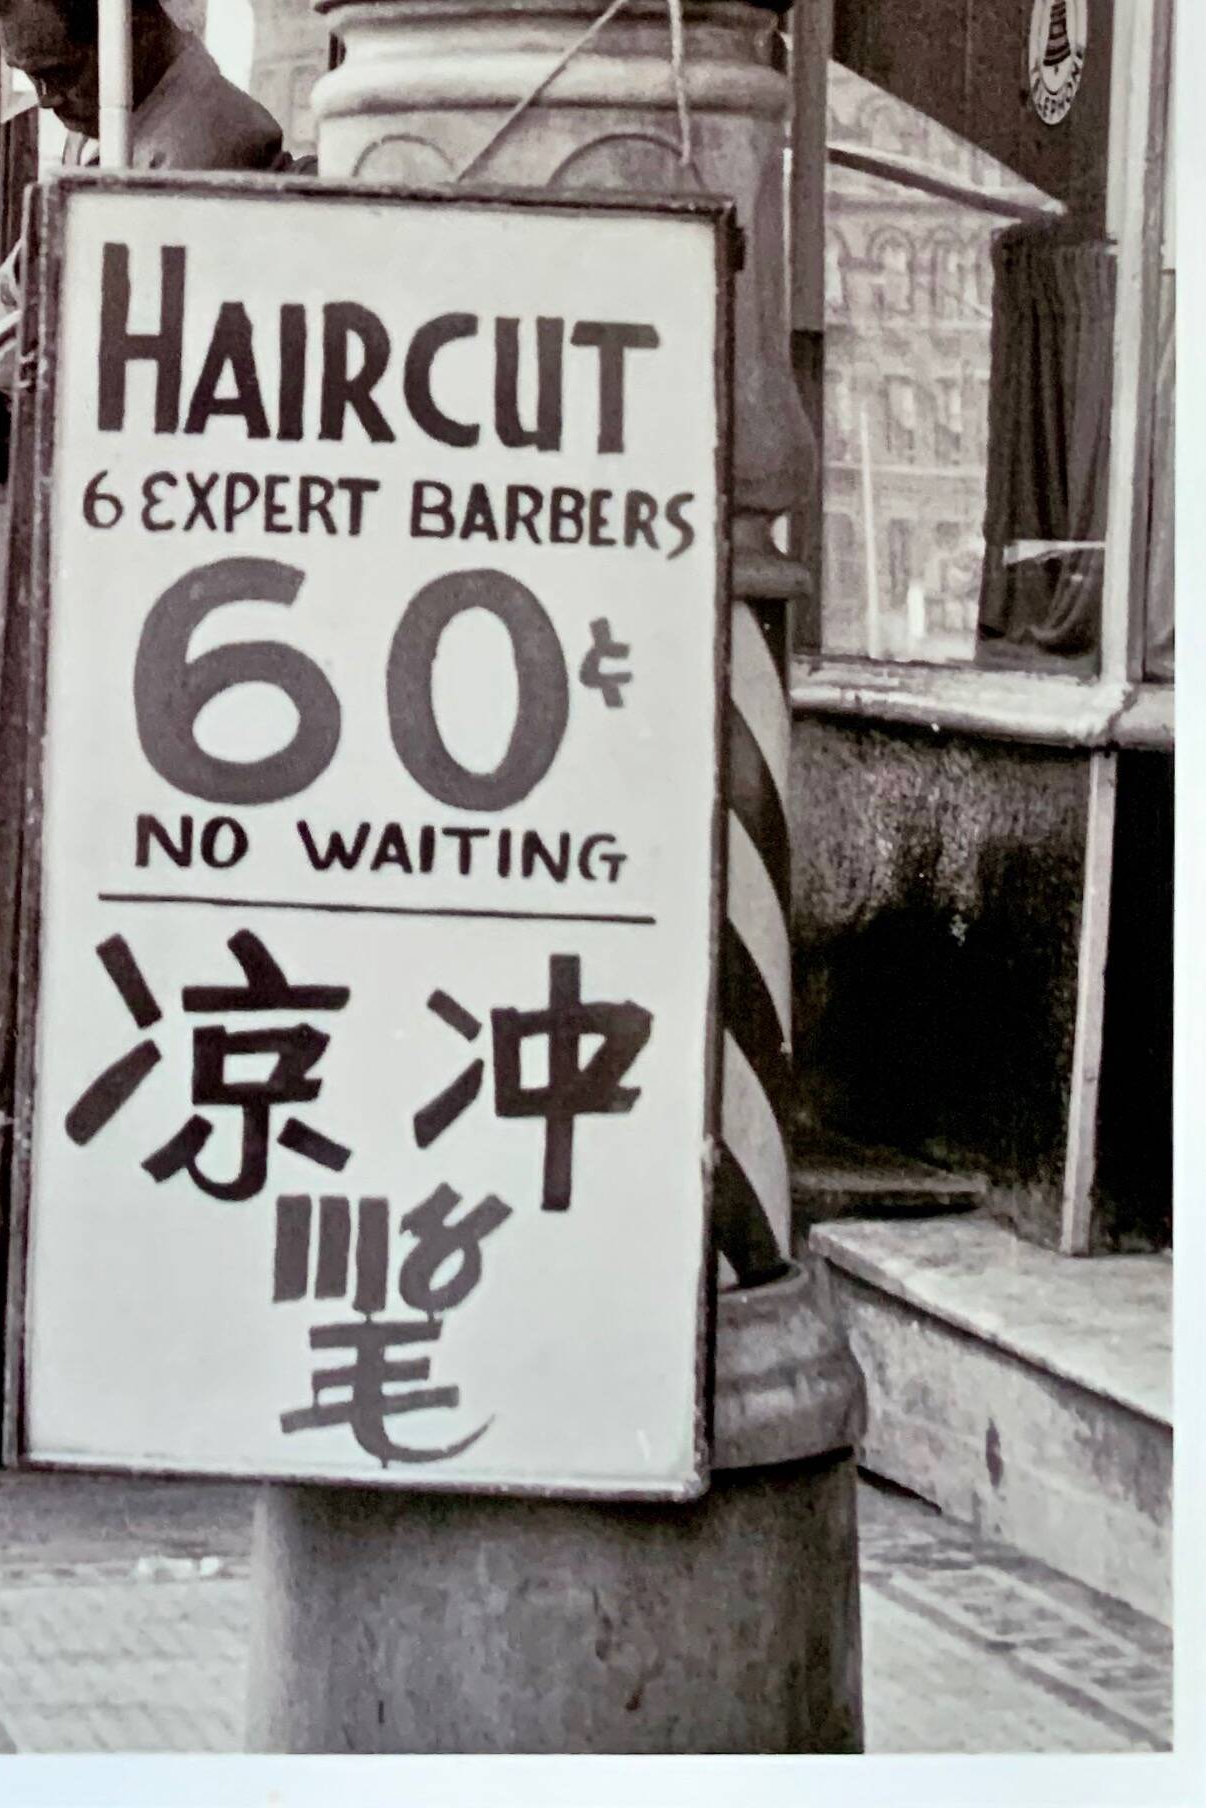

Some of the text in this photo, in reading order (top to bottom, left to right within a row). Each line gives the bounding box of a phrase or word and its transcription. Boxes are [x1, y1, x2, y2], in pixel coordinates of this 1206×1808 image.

[97, 242, 660, 454] HAIRCUT
[82, 469, 695, 560] 6 EXPERT BARBERS
[135, 814, 628, 884] NO WAITING
